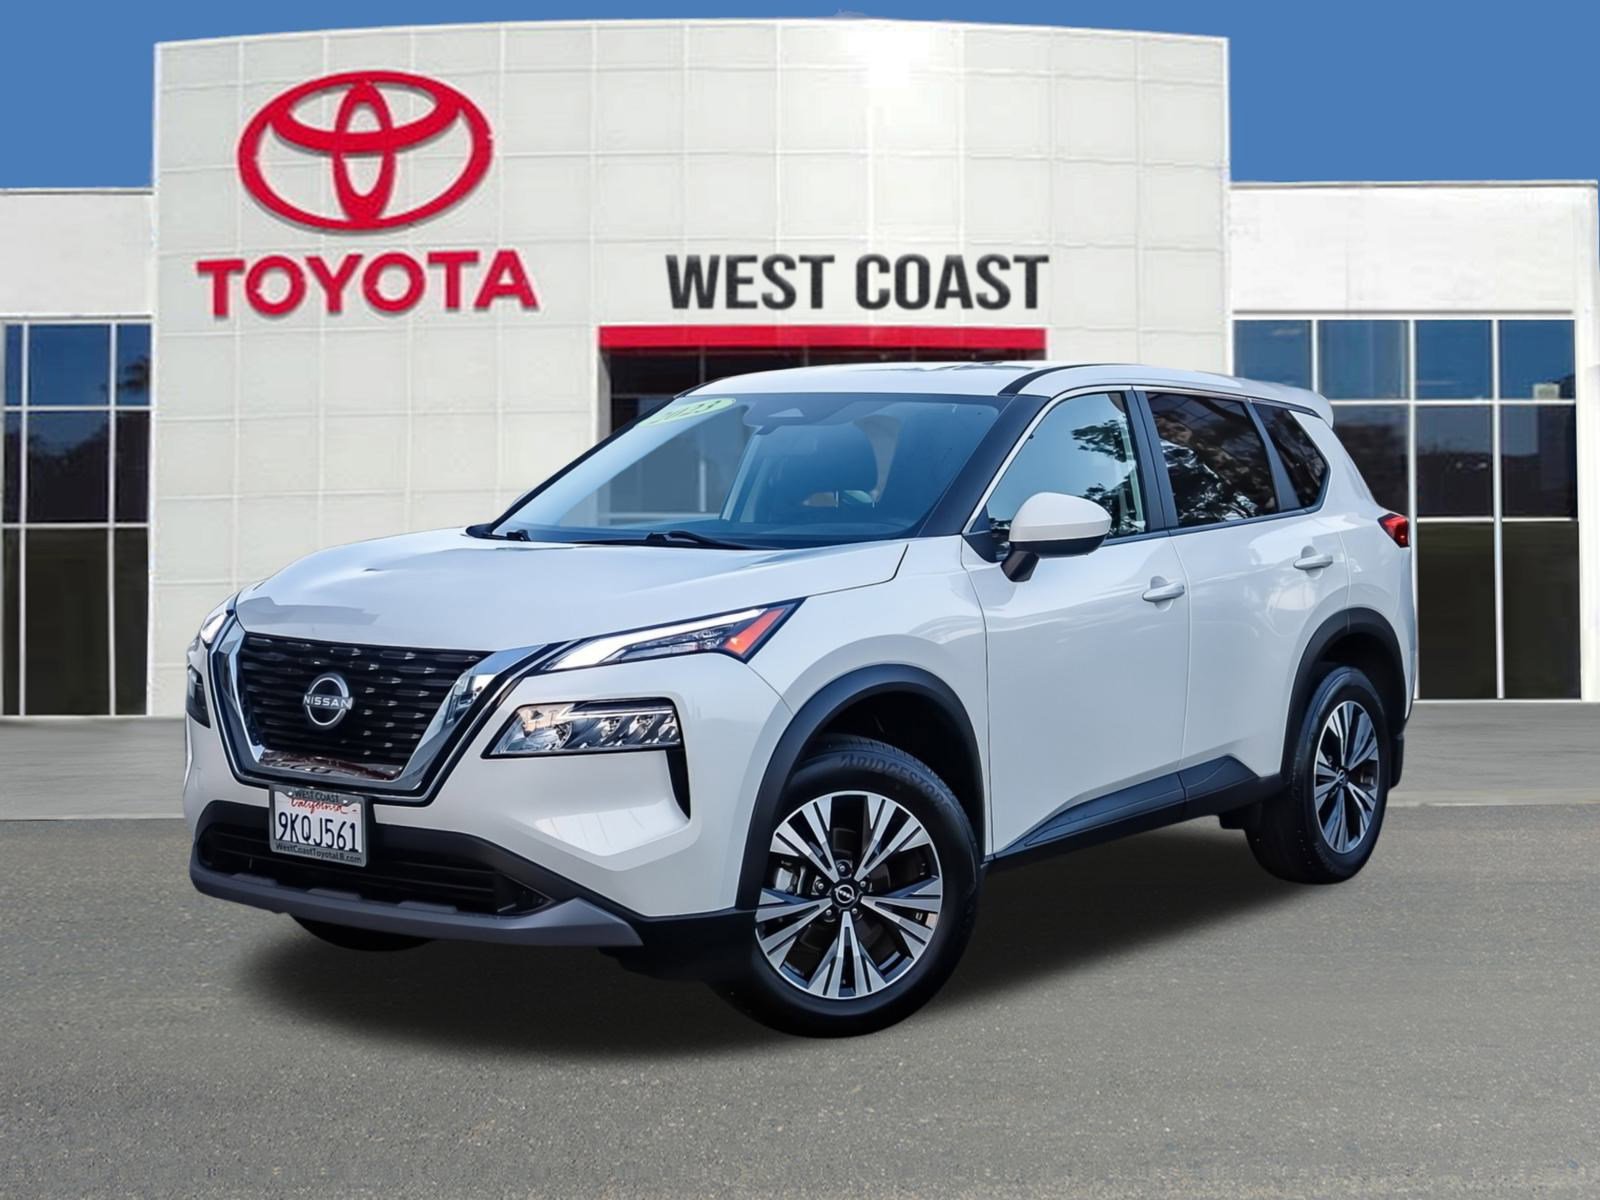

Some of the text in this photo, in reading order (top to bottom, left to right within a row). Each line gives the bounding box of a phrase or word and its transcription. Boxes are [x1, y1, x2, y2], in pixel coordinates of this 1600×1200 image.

[196, 250, 539, 317] TOYOTA
[666, 254, 1049, 310] WEST COAST
[303, 694, 353, 710] NISSAN
[290, 797, 349, 814] California
[292, 789, 340, 803] WEST COAST
[278, 811, 359, 853] 9KQJ561
